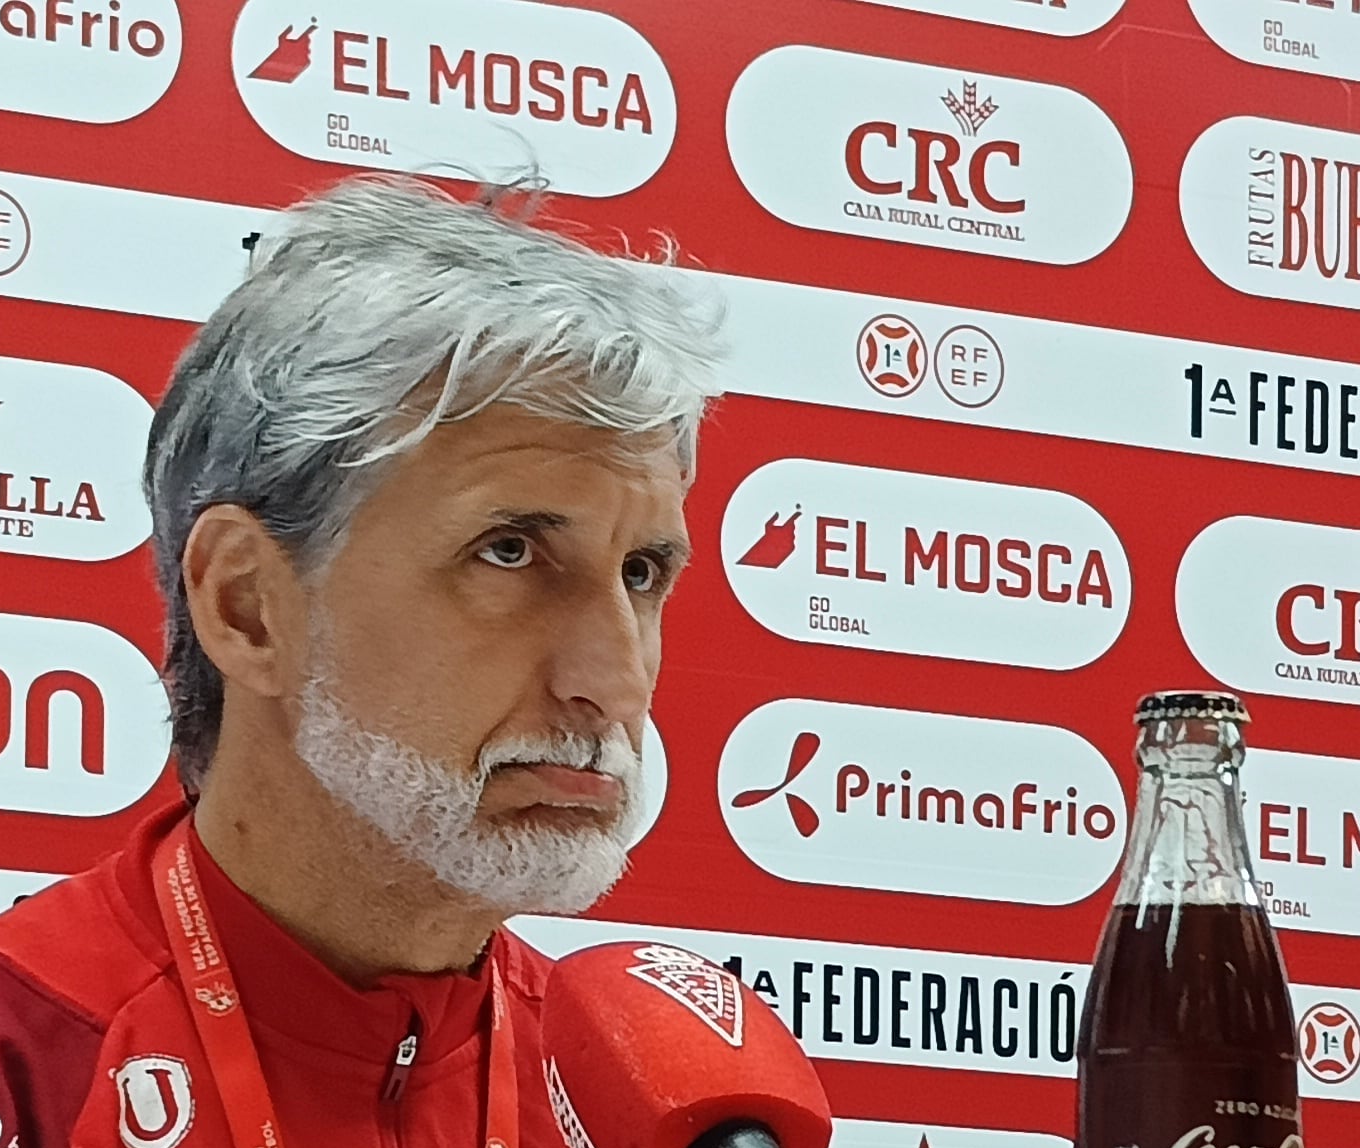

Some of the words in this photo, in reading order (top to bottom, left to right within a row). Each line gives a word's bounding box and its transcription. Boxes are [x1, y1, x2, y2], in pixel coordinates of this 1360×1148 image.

[1264, 20, 1283, 36] GO
[1264, 36, 1320, 59] GLOBAL
[332, 30, 410, 101] EL
[429, 44, 653, 135] MOSCA
[327, 112, 349, 131] GO
[327, 131, 392, 156] GLOBAL
[844, 121, 1026, 214] CRC
[843, 201, 884, 223] CAJA
[887, 206, 944, 231] RURAL
[946, 215, 1025, 243] CENTRAL
[1247, 147, 1276, 268] FRUTAS
[815, 516, 887, 582] EL
[904, 527, 1113, 610] MOSCA
[809, 596, 830, 614] GO
[809, 613, 870, 636] GLOBAL
[1274, 662, 1314, 683] CAJA
[836, 763, 1116, 842] PrimaFrio
[1260, 803, 1326, 866] EL
